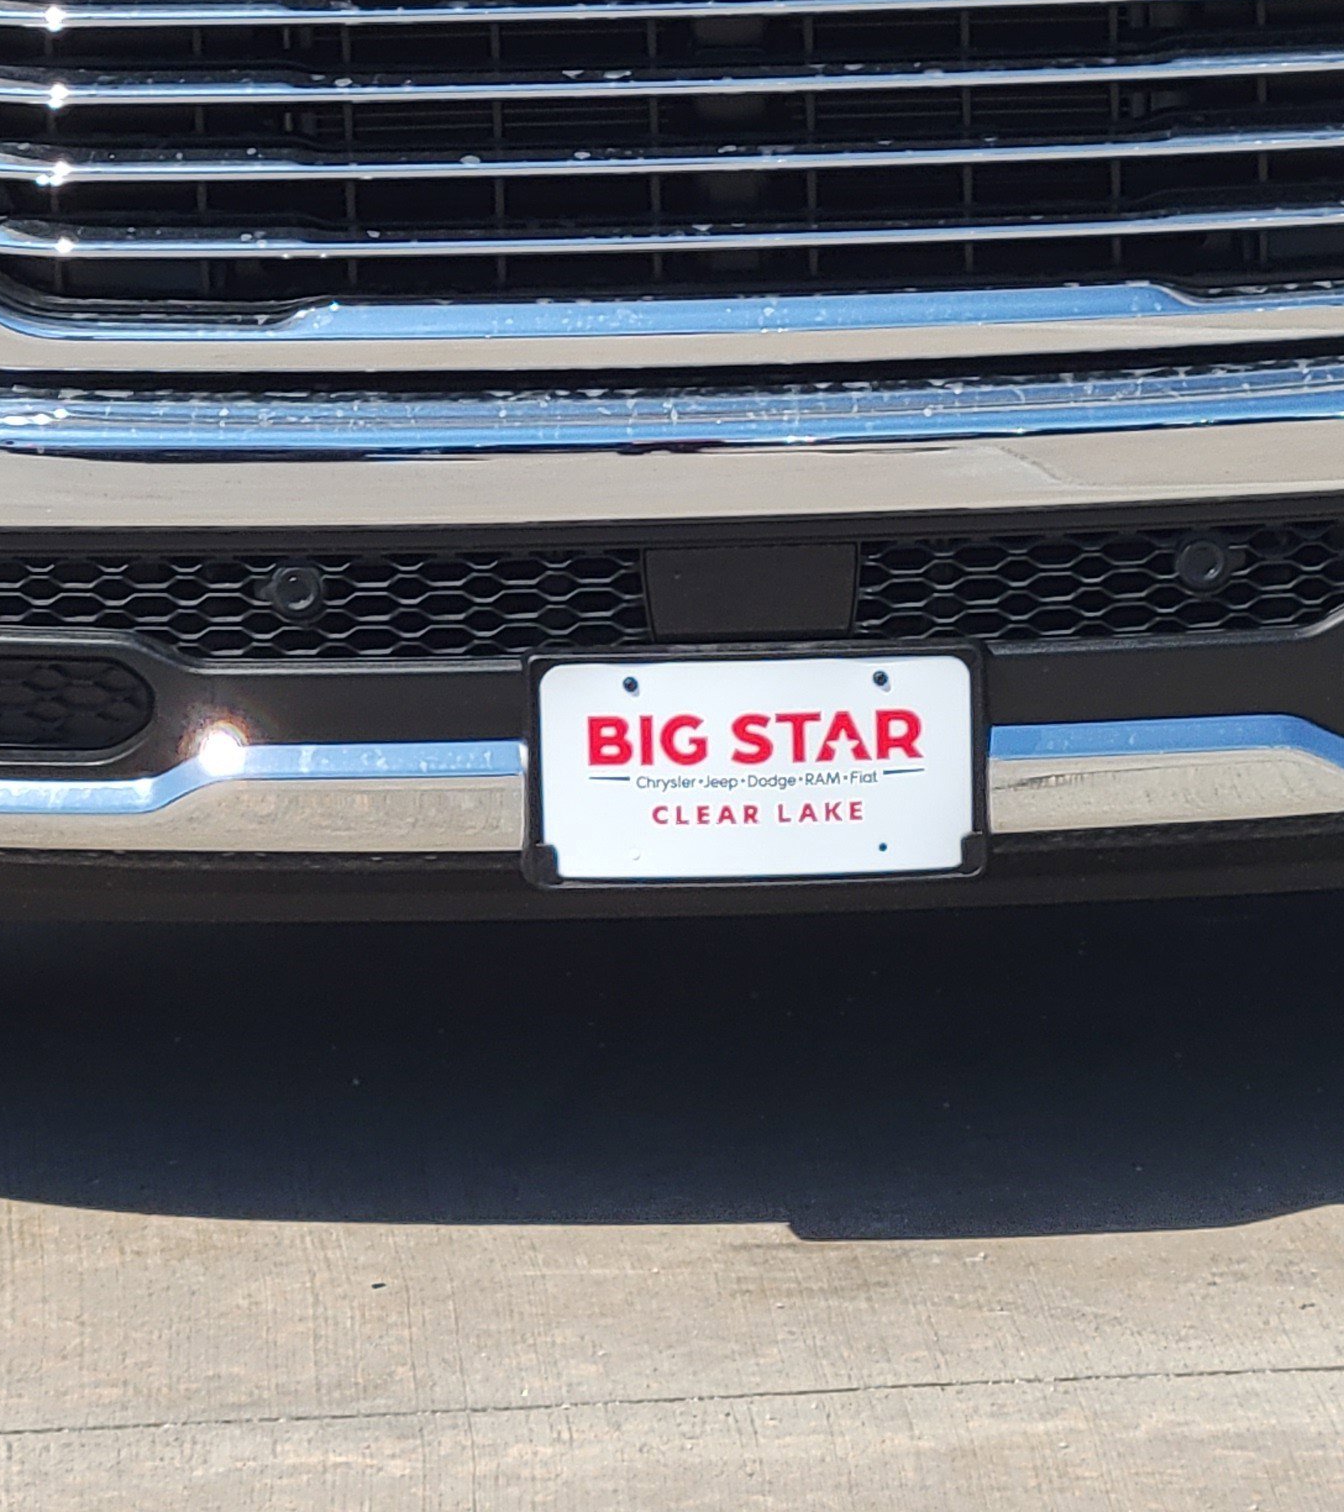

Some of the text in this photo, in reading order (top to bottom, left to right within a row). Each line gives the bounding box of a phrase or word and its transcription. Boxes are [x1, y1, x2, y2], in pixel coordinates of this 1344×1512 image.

[587, 708, 925, 766] BIG STAR
[635, 769, 879, 793] Chrysler Jeep Dodge RAM Fiat
[651, 800, 864, 826] CLEAR LAKE
